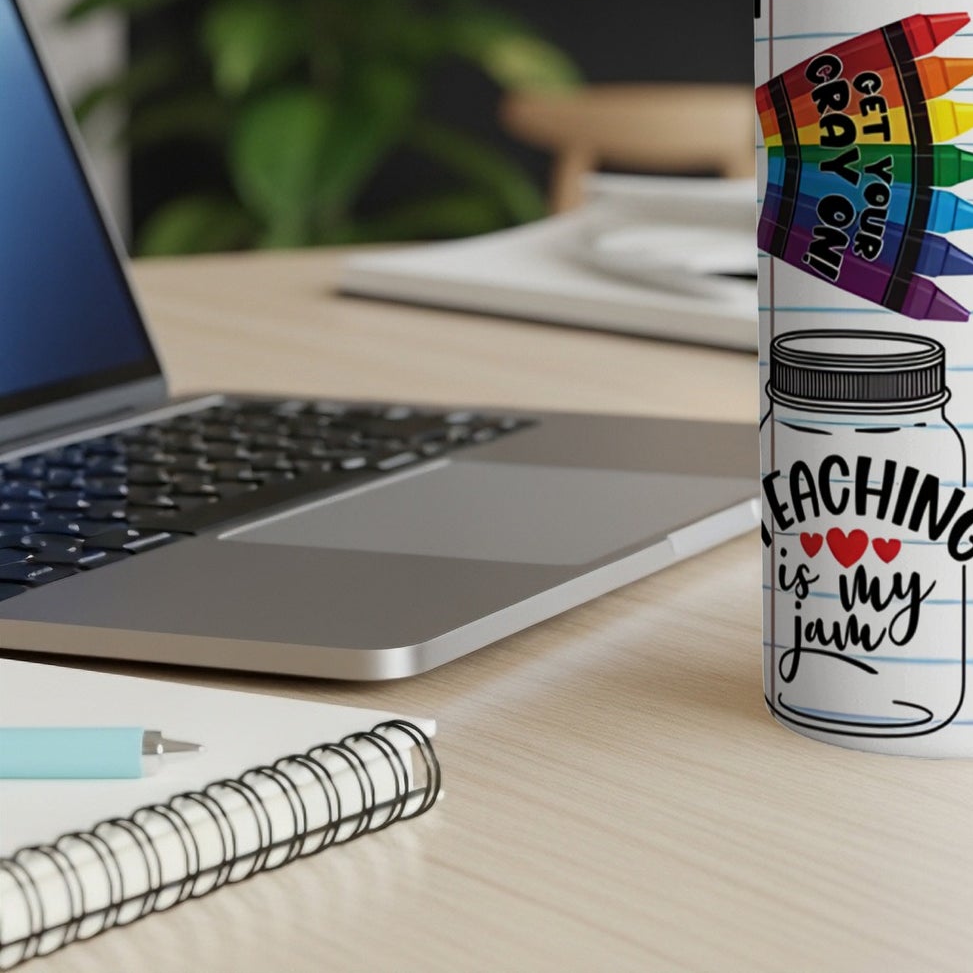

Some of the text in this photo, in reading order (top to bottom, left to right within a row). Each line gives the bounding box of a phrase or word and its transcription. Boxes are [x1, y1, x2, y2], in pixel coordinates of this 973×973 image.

[801, 53, 862, 283] CRAY ON!
[852, 71, 894, 263] GET YOUR
[778, 547, 937, 647] is my
[778, 600, 887, 684] jam
